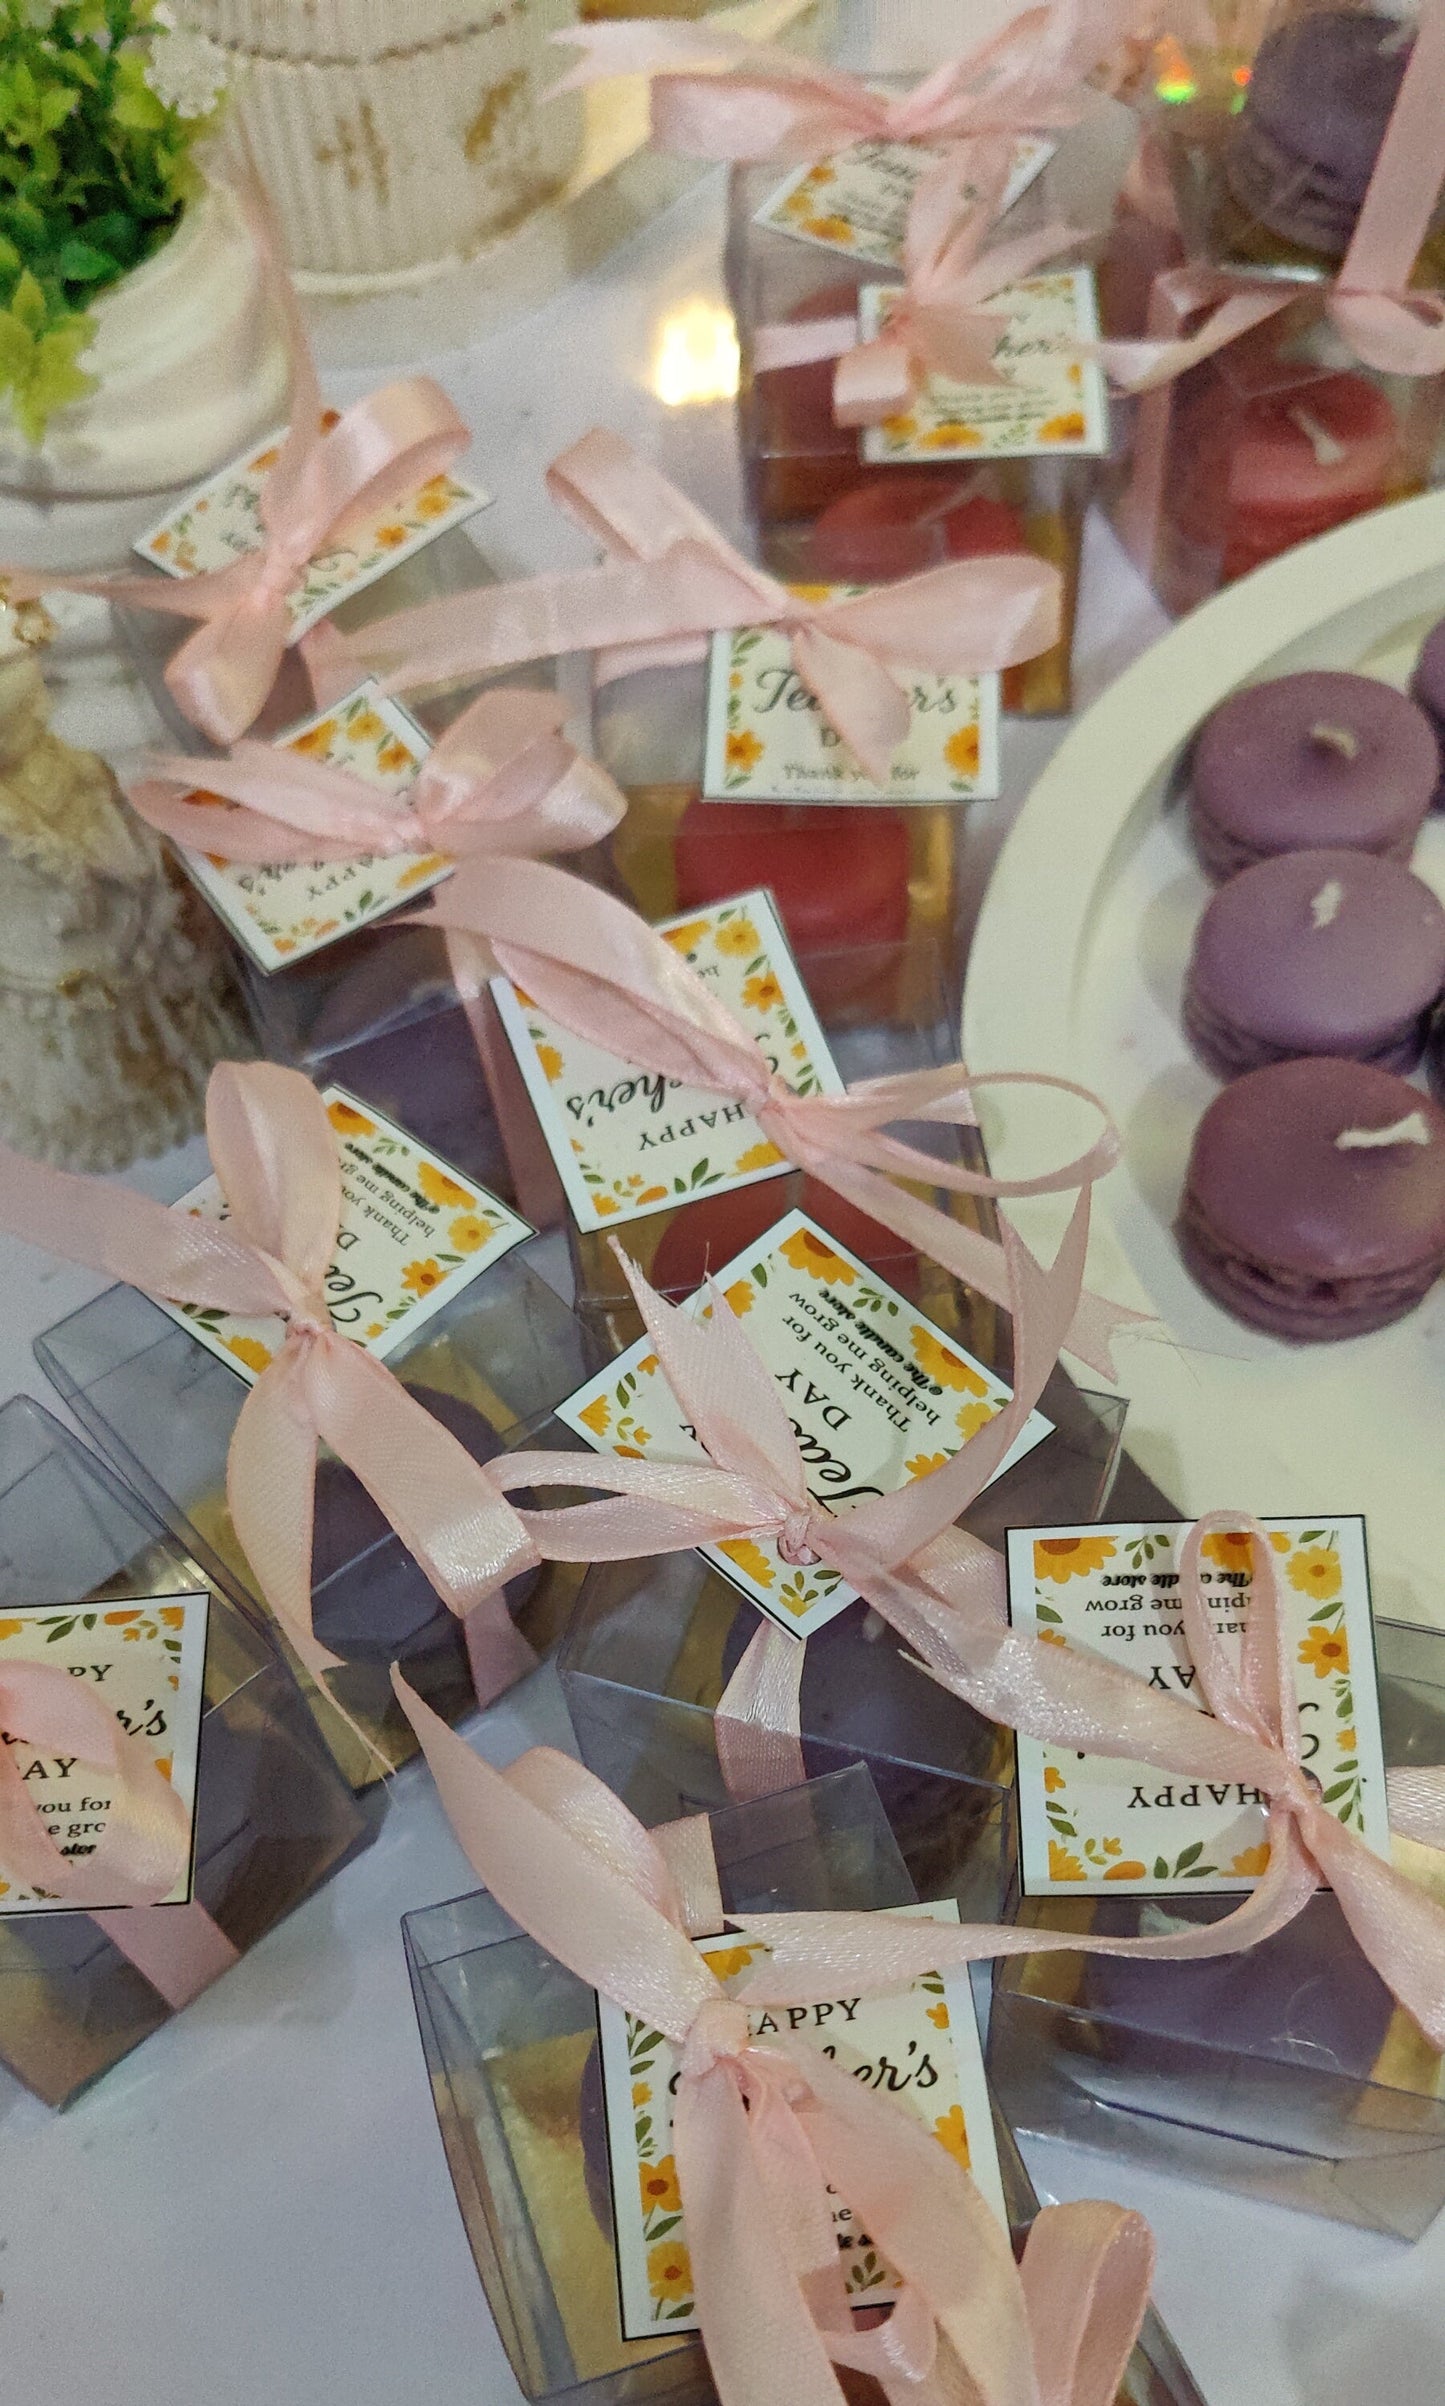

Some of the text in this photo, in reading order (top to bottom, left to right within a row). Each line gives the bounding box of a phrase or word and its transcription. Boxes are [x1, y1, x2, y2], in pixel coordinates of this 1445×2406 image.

[638, 1101, 748, 1152] HAPPY
[356, 1174, 379, 1194] me
[363, 1205, 410, 1246] Thank
[379, 1190, 436, 1238] helping
[818, 1287, 856, 1321] store
[855, 1319, 904, 1364] candle
[782, 1316, 912, 1432] Thank you for
[788, 1292, 942, 1426] helping me grow
[774, 1367, 852, 1431] DAY
[1102, 1573, 1147, 1588] store
[1085, 1594, 1183, 1612] me grow
[1101, 1619, 1186, 1641] you for
[1148, 1664, 1196, 1690] AY
[22, 1757, 78, 1781] AY
[1127, 1783, 1268, 1808] HAPPY
[59, 1842, 97, 1856] stor
[747, 1997, 861, 2036] APPY
